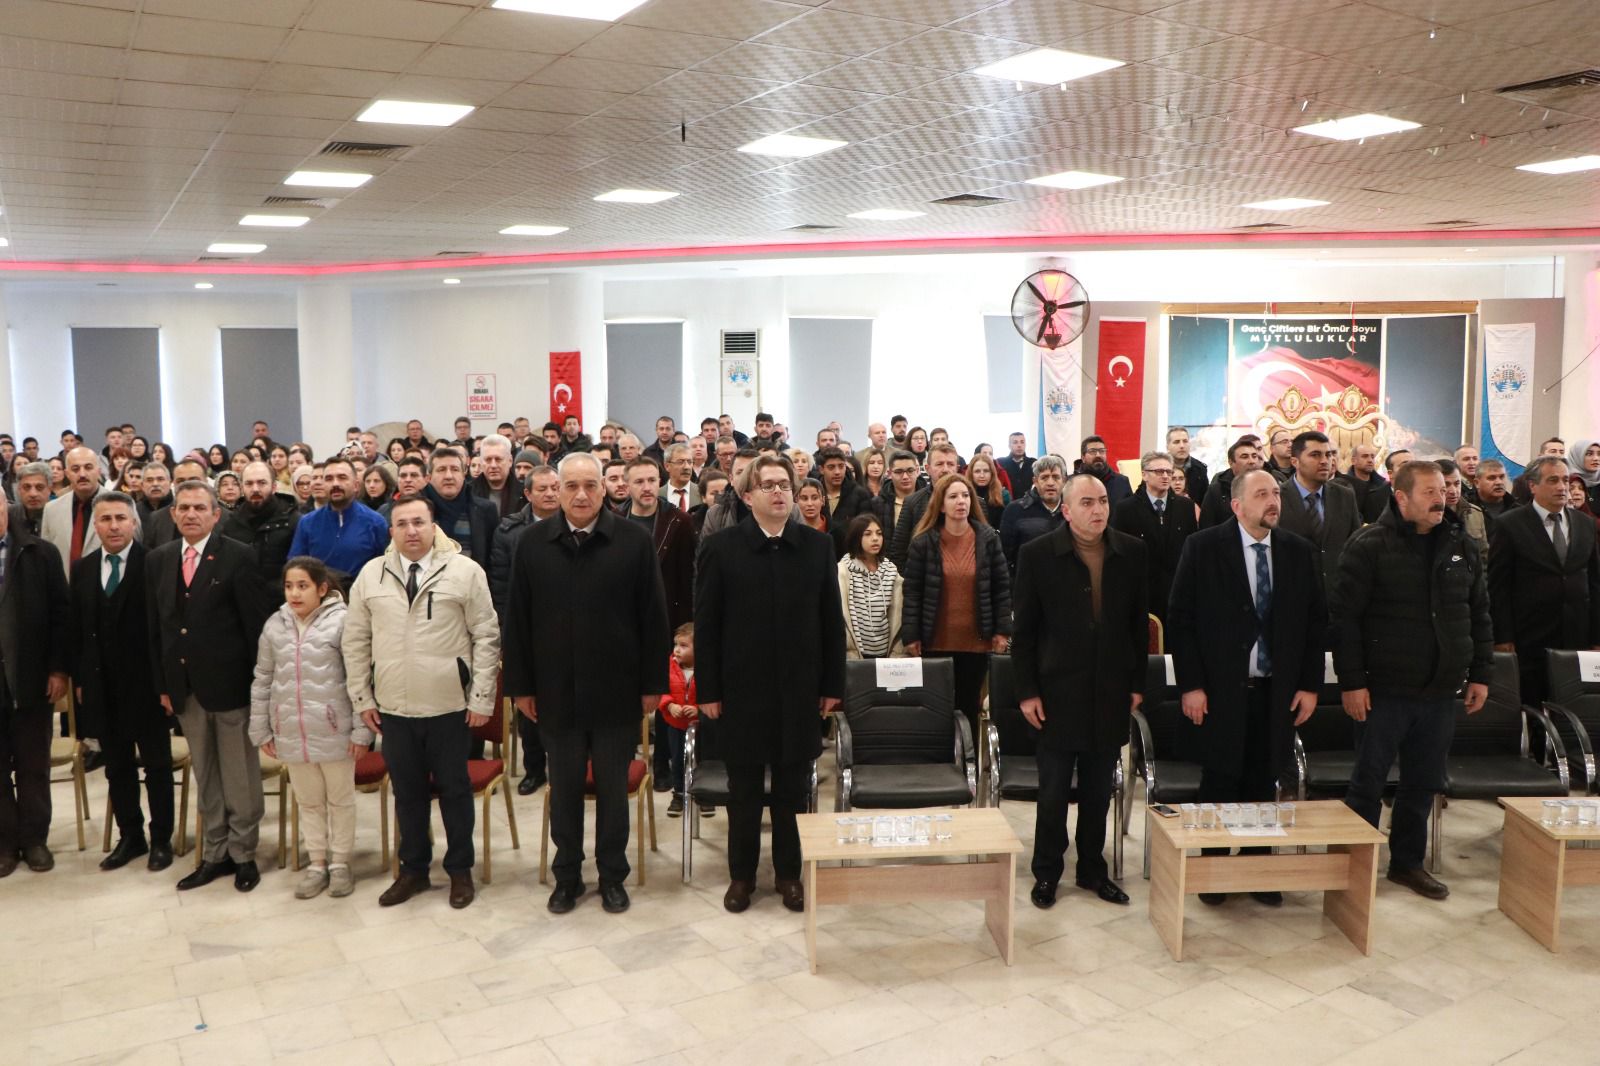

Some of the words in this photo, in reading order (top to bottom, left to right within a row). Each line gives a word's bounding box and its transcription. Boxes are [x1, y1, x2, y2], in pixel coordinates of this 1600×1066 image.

[1241, 324, 1267, 334] Genç
[1268, 324, 1306, 334] Çiftlere
[1306, 324, 1321, 333] Bir
[1322, 323, 1351, 333] Ömür
[1352, 325, 1377, 335] Boyu
[1250, 334, 1367, 343] MUTLULUKLAR
